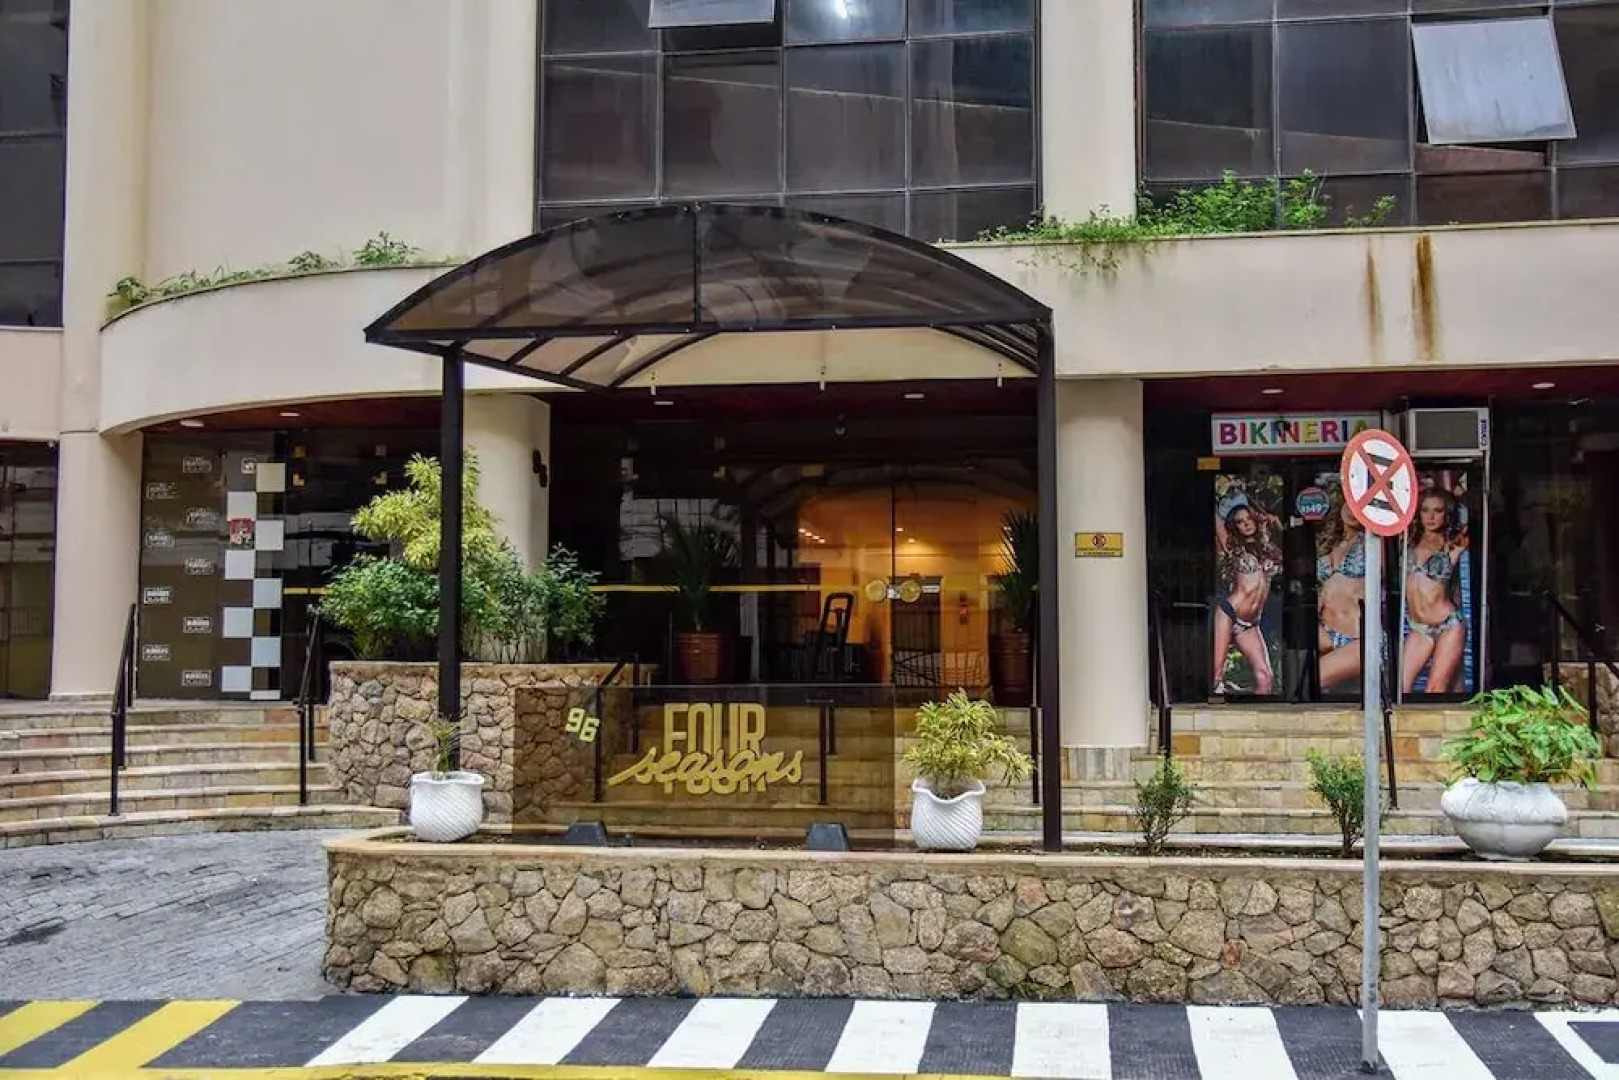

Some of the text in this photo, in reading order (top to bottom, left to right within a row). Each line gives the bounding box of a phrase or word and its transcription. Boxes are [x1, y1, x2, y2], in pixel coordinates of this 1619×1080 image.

[565, 708, 600, 743] 96
[608, 747, 803, 787] seasons
[664, 702, 767, 794] FOUR
